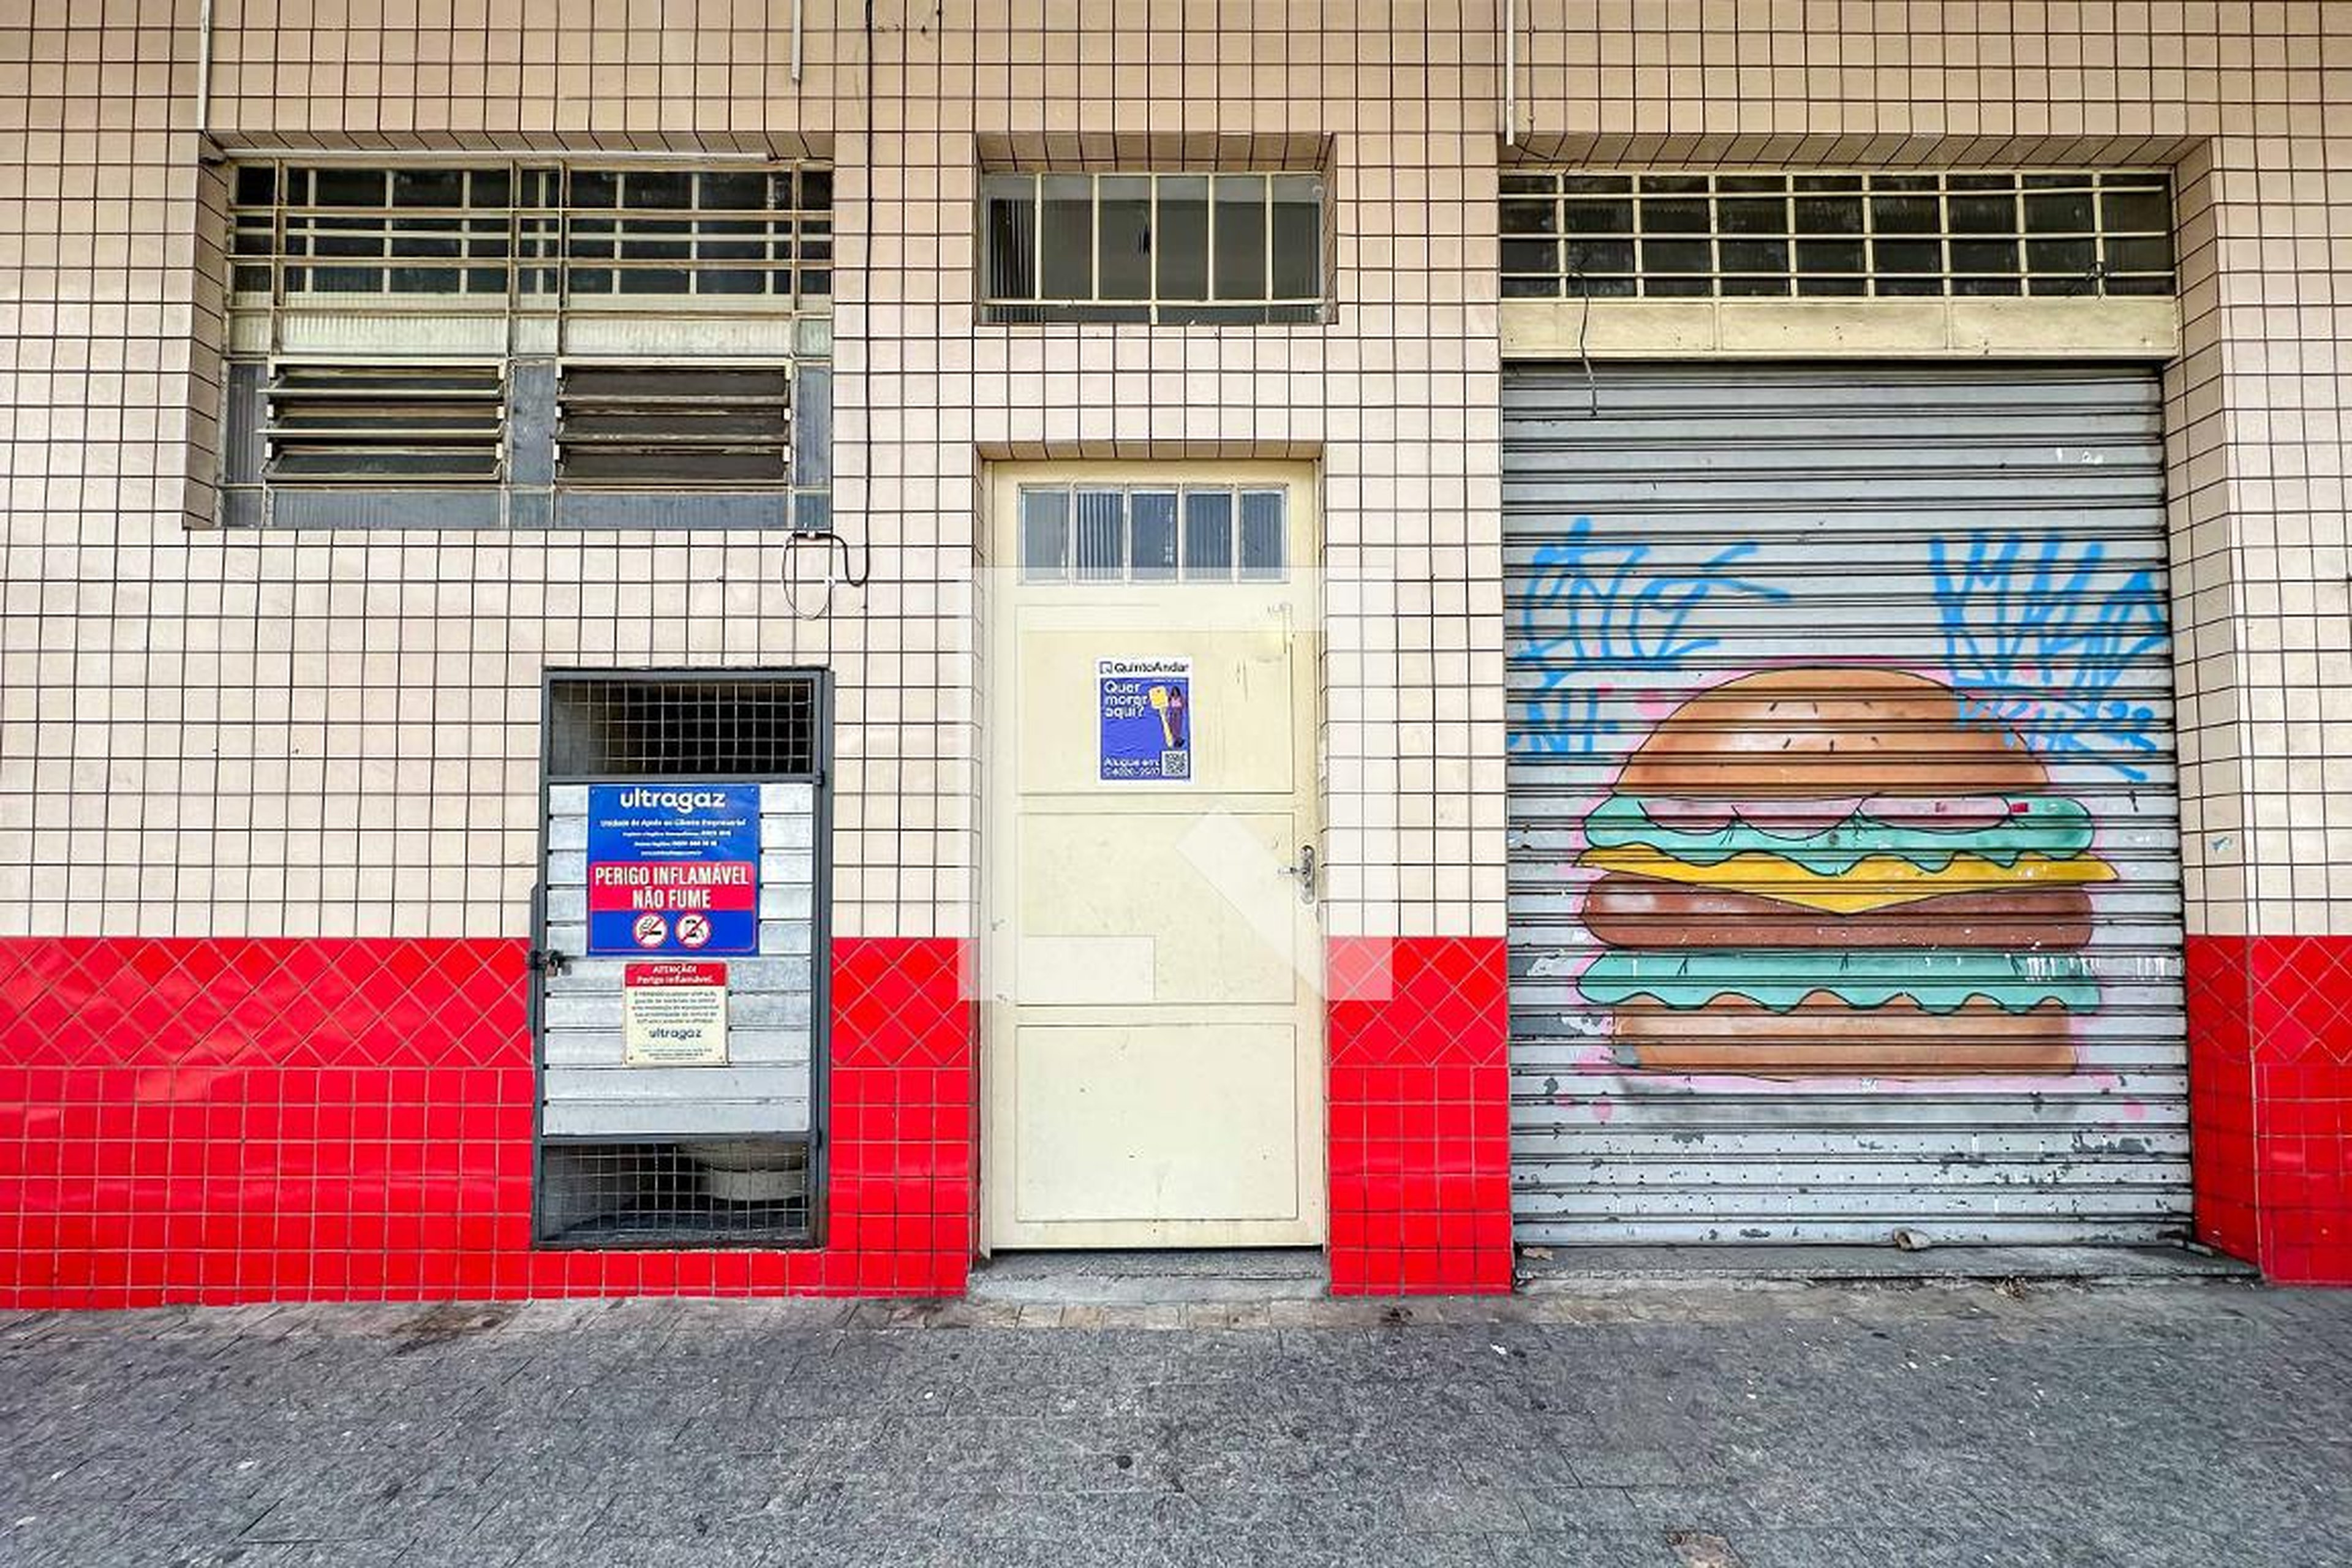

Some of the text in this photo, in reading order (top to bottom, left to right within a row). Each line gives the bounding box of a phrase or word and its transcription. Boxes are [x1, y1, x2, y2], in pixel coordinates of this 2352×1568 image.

[1114, 662, 1189, 673] QuintoAndar
[1105, 680, 1140, 693] Quer
[1105, 706, 1144, 719] aqui?
[620, 787, 726, 813] ultragaz
[595, 862, 750, 886] PERIGO INFLAMÁVEL
[632, 887, 711, 908] NÃO FUME
[649, 1027, 703, 1041] ultragaz
